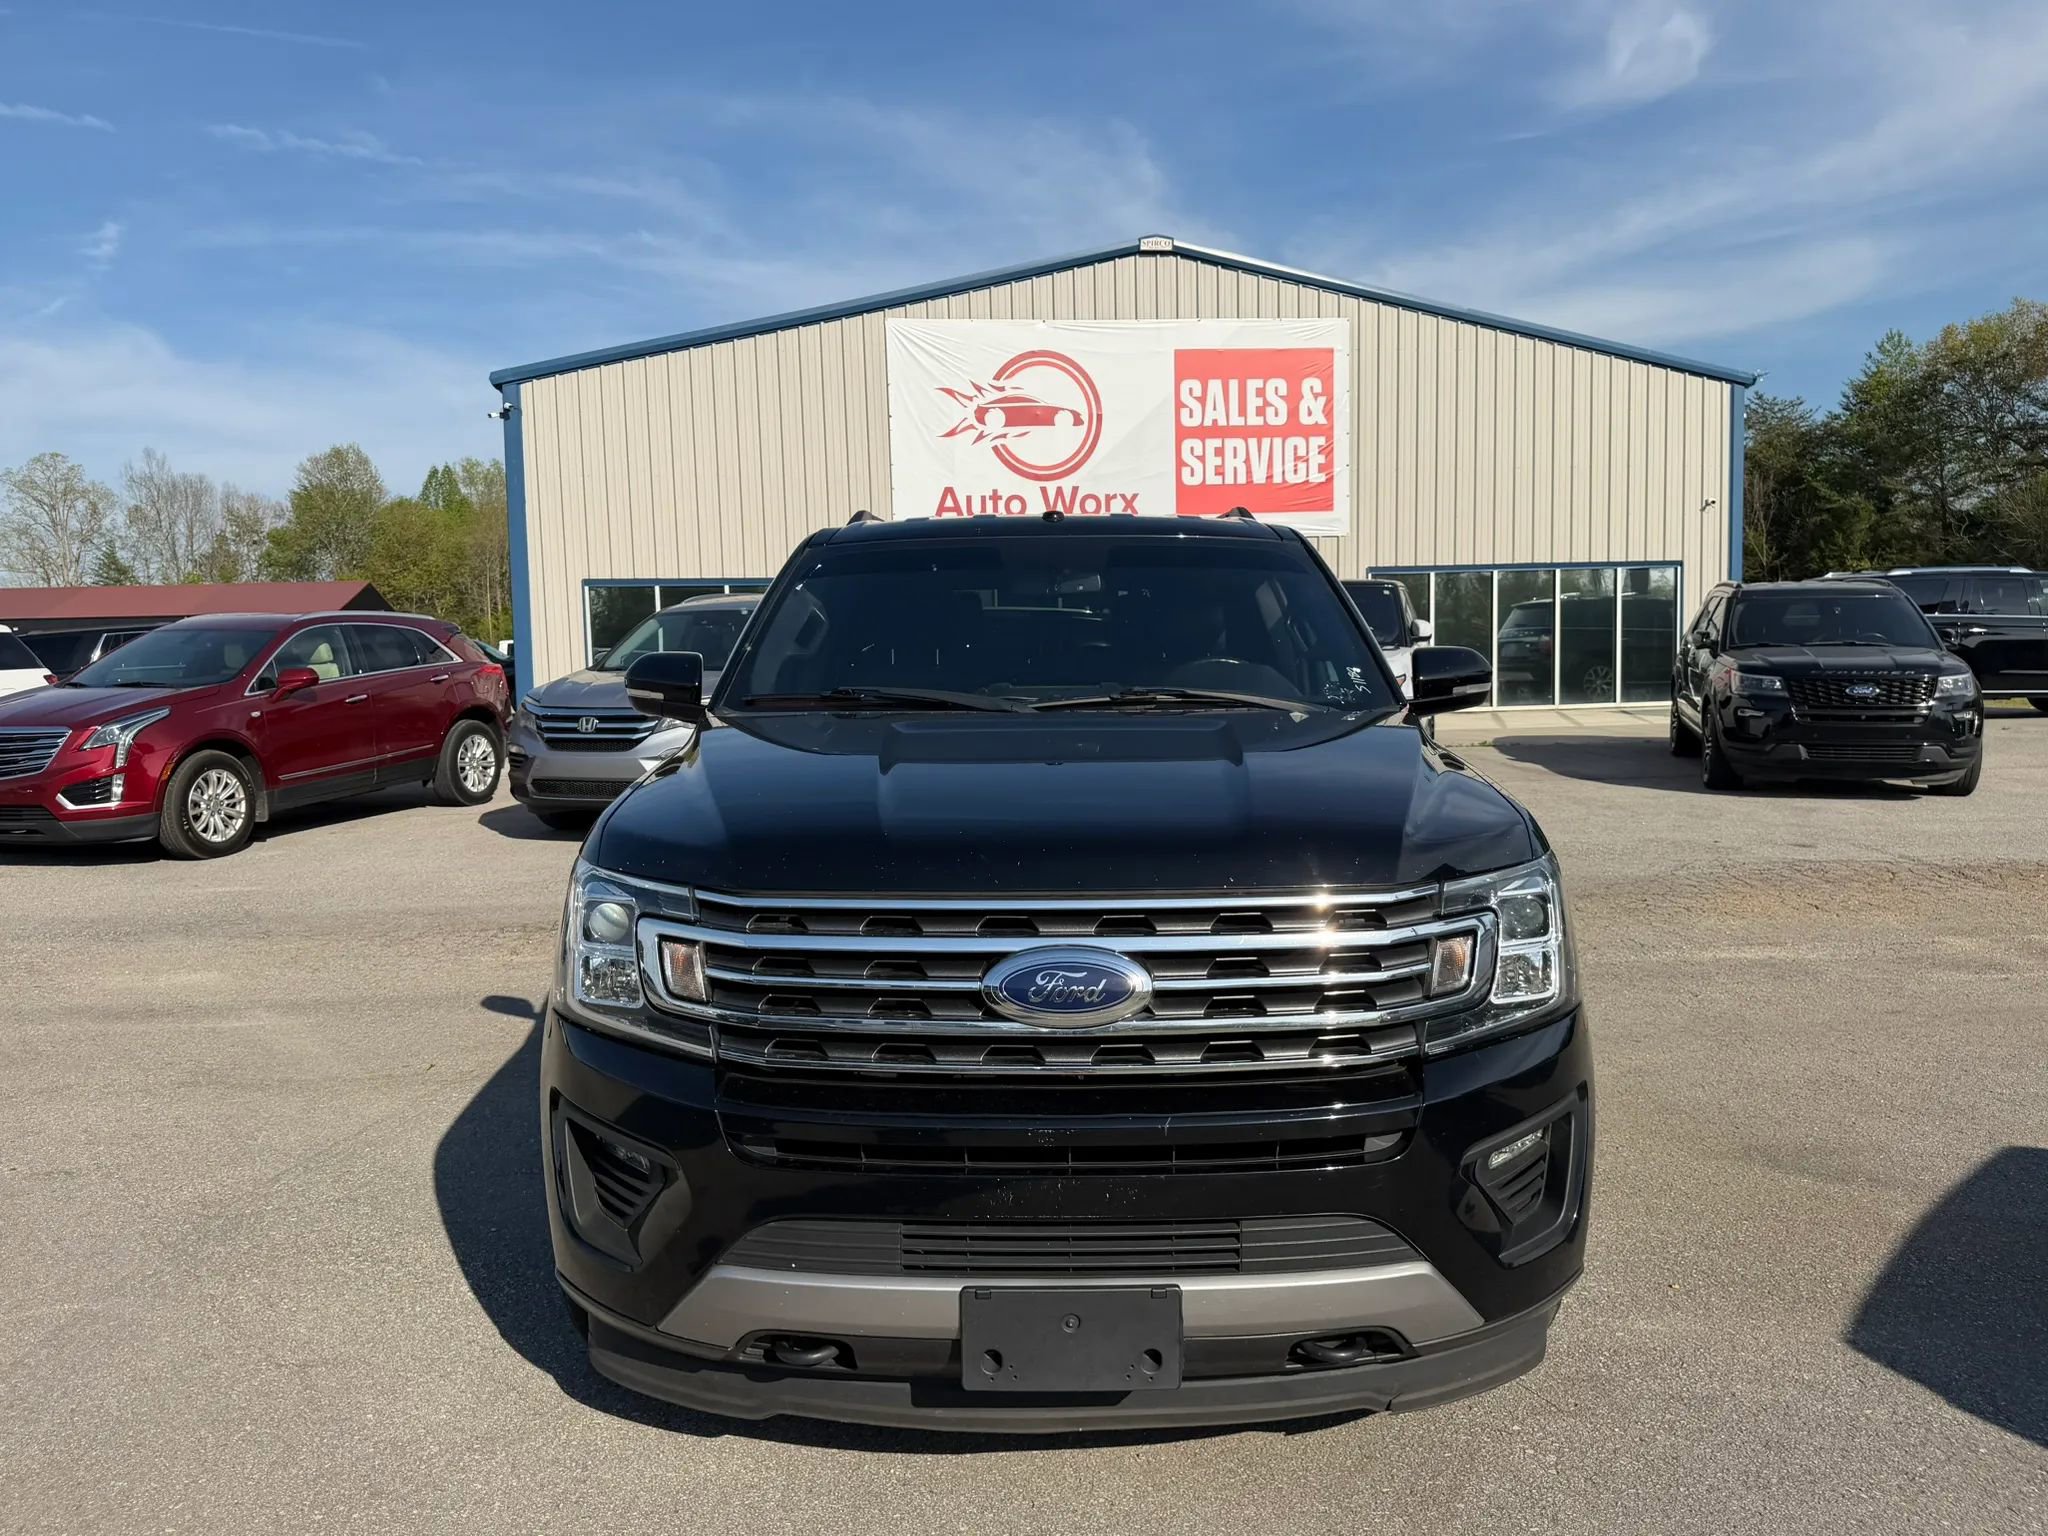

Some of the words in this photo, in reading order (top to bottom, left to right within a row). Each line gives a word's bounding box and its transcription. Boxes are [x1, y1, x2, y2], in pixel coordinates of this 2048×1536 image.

[1180, 378, 1288, 427] SALES
[1299, 377, 1328, 425] &
[1181, 436, 1326, 485] SERVICE
[934, 486, 1027, 517] Auto
[1040, 486, 1139, 515] Worx
[1028, 969, 1107, 1004] Ford
